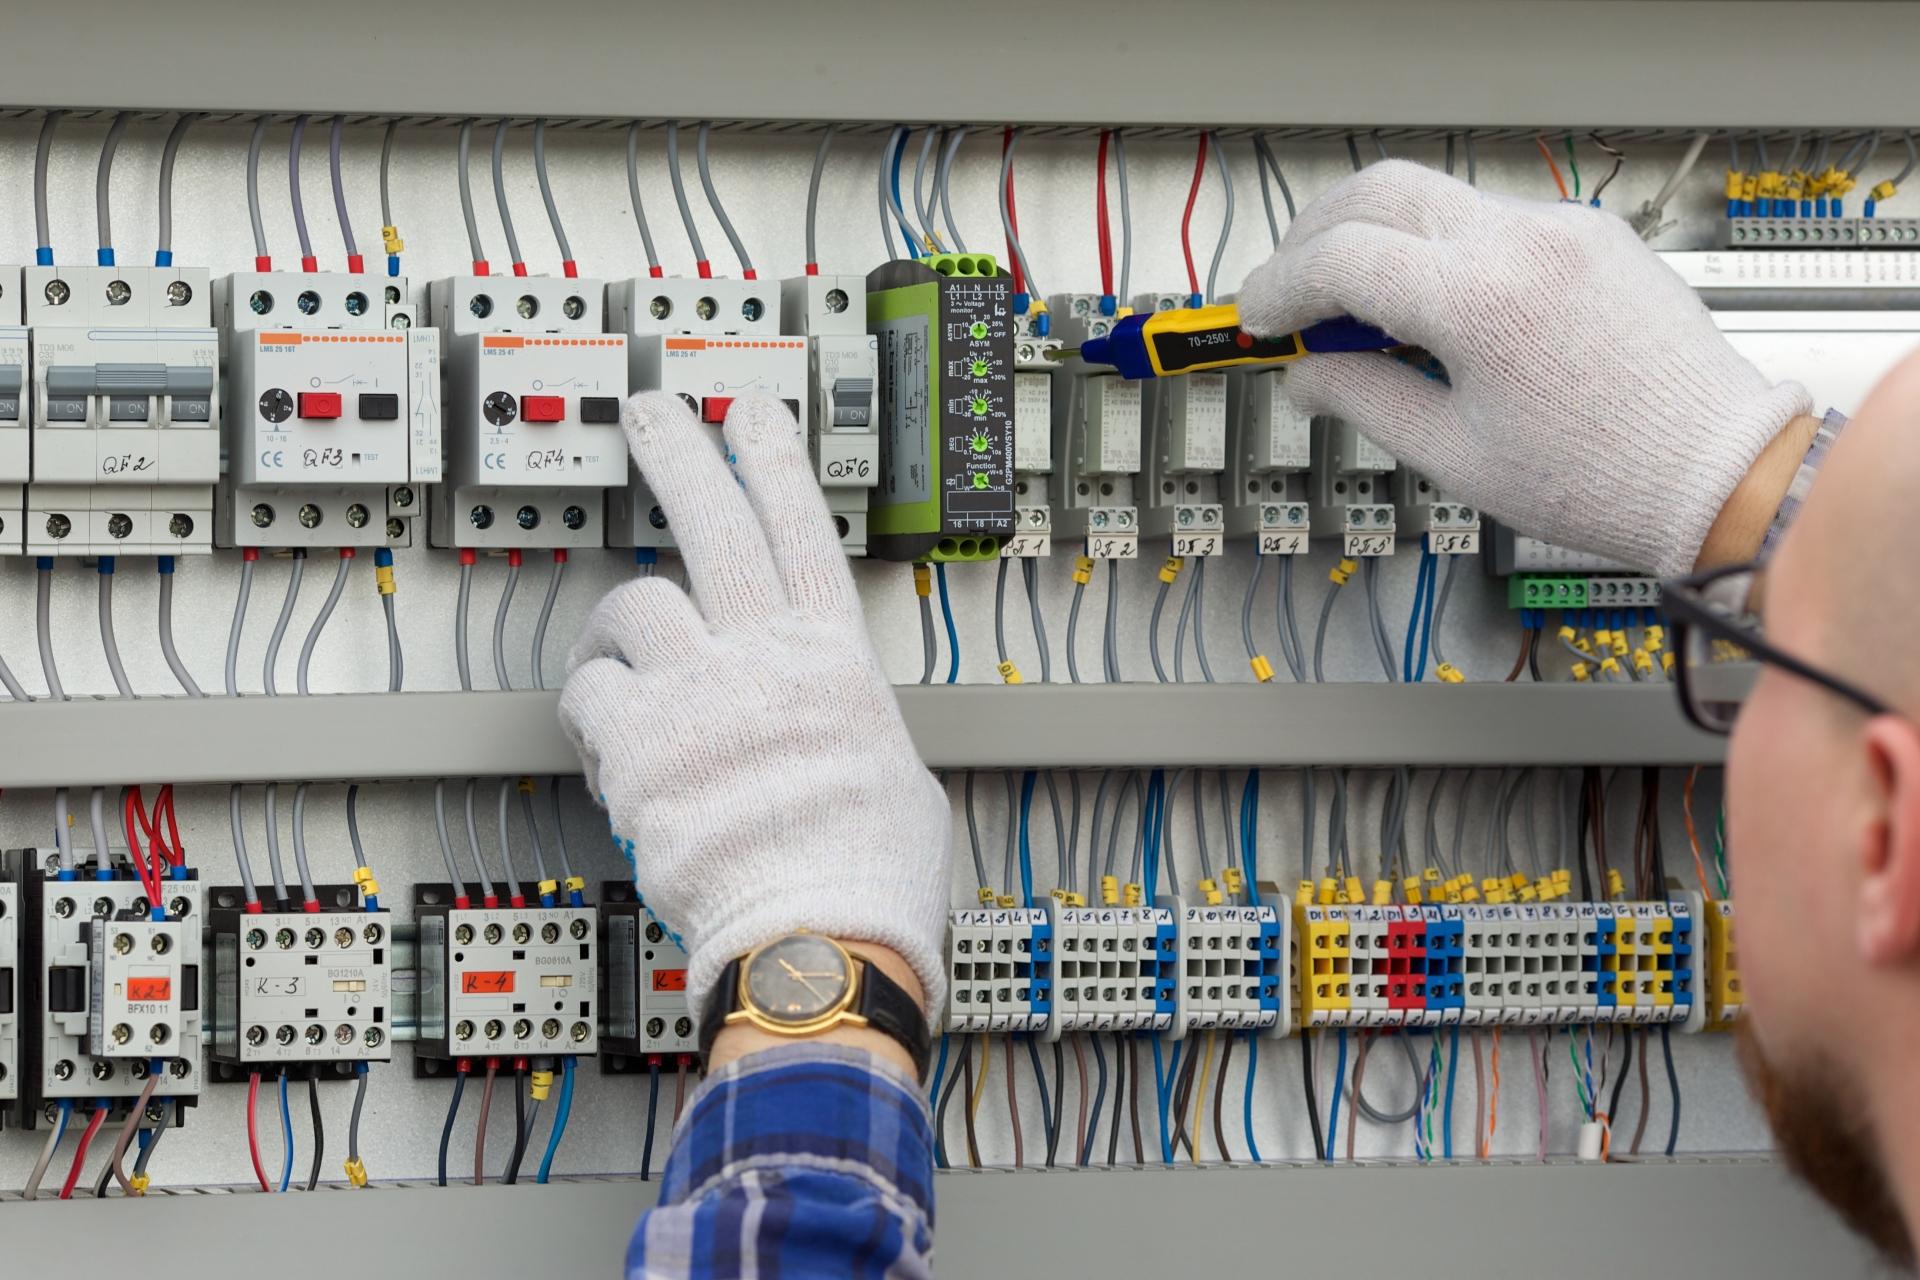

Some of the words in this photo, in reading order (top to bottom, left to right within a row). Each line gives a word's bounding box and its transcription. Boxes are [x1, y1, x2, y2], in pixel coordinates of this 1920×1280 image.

[950, 293, 960, 301] L1
[972, 293, 982, 301] L2
[995, 293, 1005, 301] L3
[66, 402, 84, 413] ON
[128, 402, 145, 414] ON
[189, 402, 206, 414] ON
[850, 409, 866, 420] ON
[364, 453, 379, 461] TEST
[972, 453, 992, 461] Delay
[996, 520, 1008, 528] A2
[182, 884, 197, 893] 10A
[538, 912, 547, 921] 13
[564, 911, 574, 919] A1
[960, 911, 969, 924] 1
[976, 912, 988, 923] 2
[1013, 911, 1022, 922] 4
[1033, 910, 1043, 921] N
[1064, 911, 1073, 922] 4
[1082, 911, 1094, 922] 5
[1102, 911, 1111, 922] 6
[1142, 909, 1151, 920] 8
[1159, 909, 1169, 921] N
[1187, 909, 1196, 920] 9
[1206, 911, 1216, 921] 10
[1225, 910, 1236, 921] 11
[1243, 911, 1257, 921] 12
[1262, 907, 1271, 919] N
[1354, 909, 1361, 920] 1
[1369, 910, 1381, 920] 2
[1409, 908, 1419, 919] 3
[1486, 908, 1495, 918] 5
[1565, 906, 1574, 917] 9
[330, 917, 340, 926] 13
[356, 915, 368, 924] A1
[127, 1004, 155, 1014] BFX10
[159, 1004, 169, 1014] 11
[1098, 1020, 1110, 1029] 6
[1261, 1014, 1274, 1025] N
[538, 1041, 548, 1049] 14
[564, 1041, 577, 1050] A2
[330, 1047, 341, 1055] 14
[357, 1047, 369, 1056] A2
